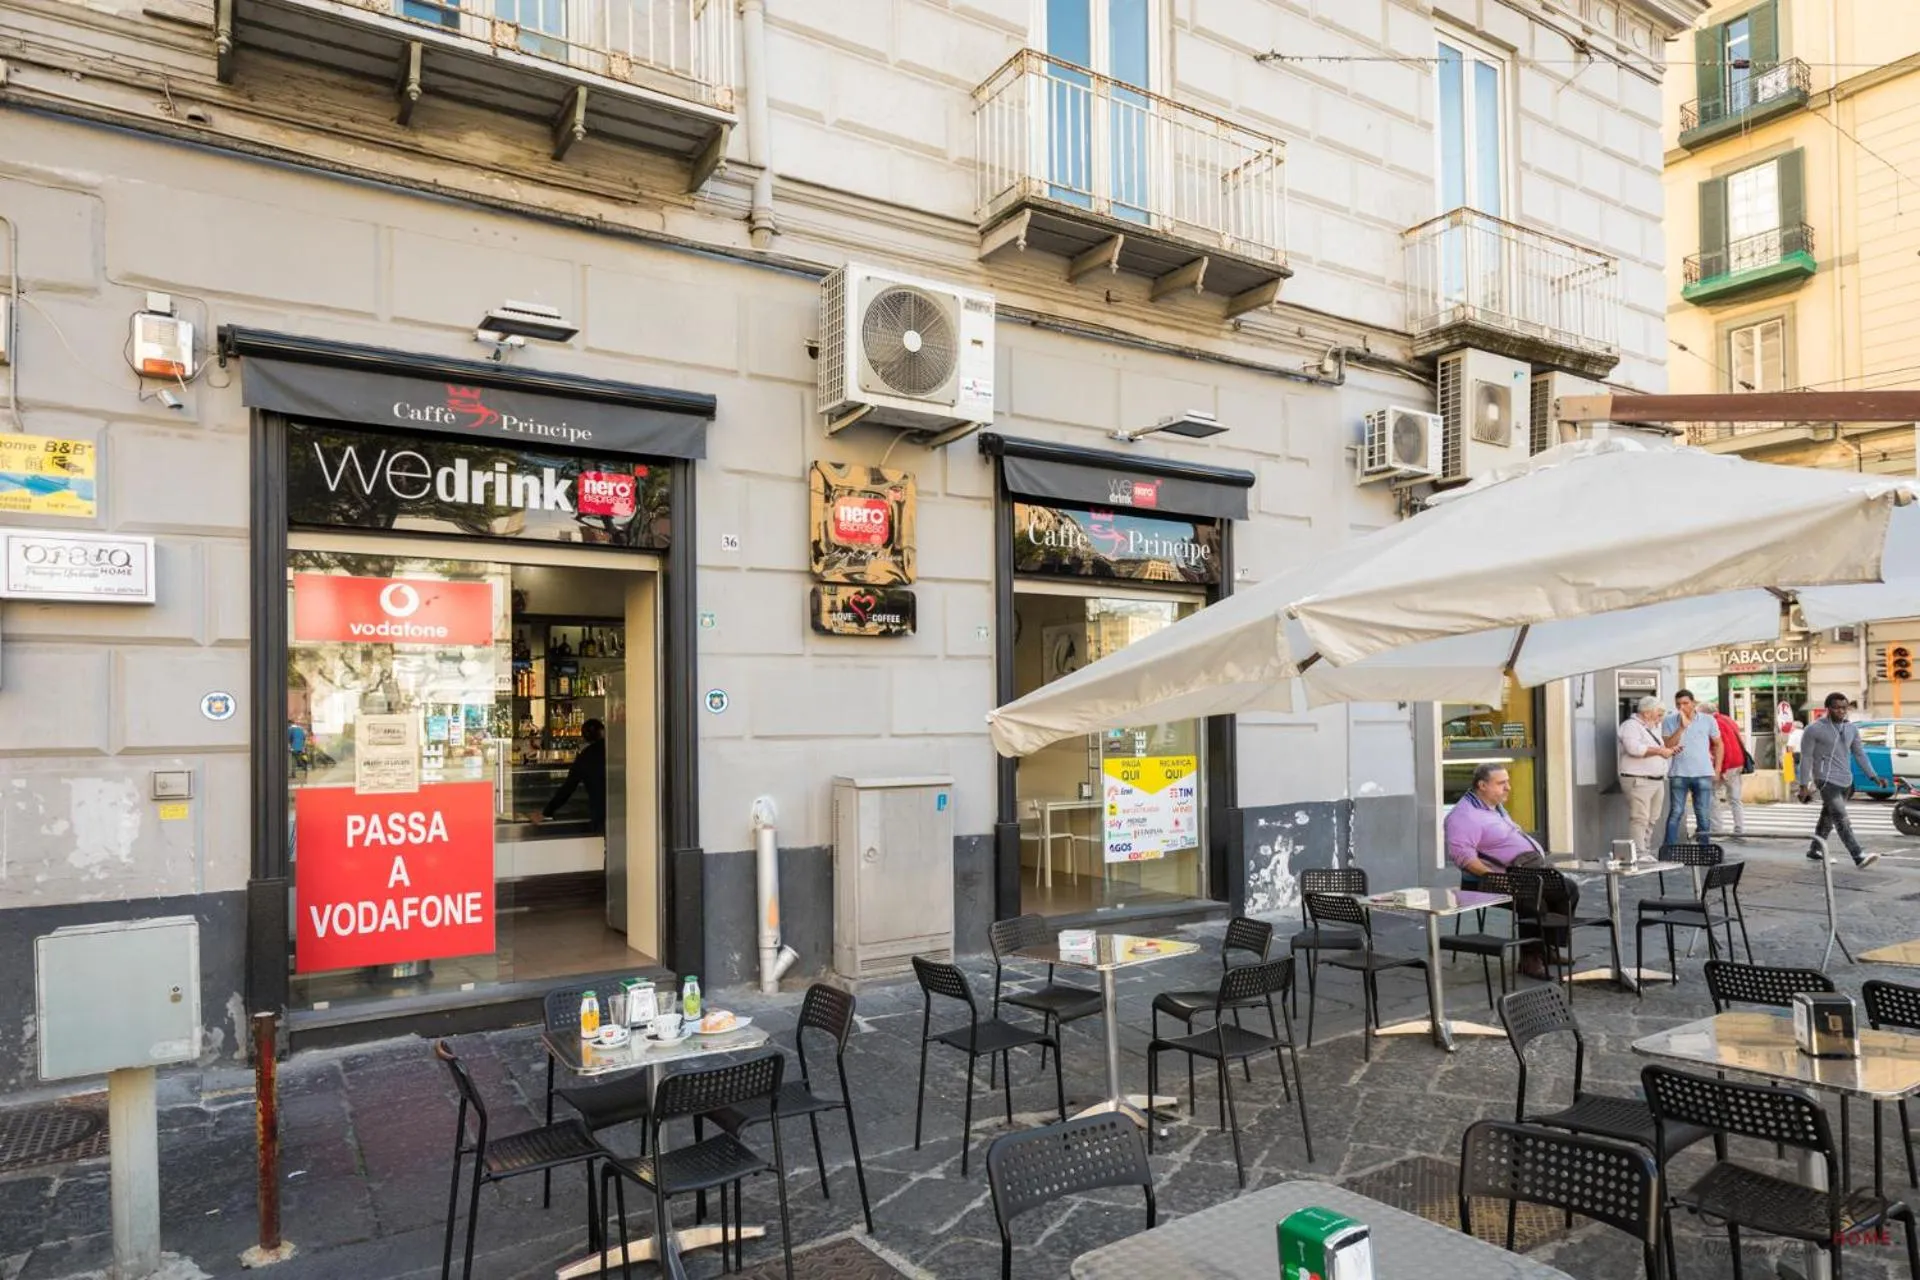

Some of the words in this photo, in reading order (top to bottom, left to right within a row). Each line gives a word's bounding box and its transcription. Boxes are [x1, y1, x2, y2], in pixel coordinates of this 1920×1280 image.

[393, 401, 456, 425] Caffè
[502, 414, 593, 442] Principe
[0, 440, 37, 452] ome
[45, 440, 85, 456] B&B
[583, 479, 631, 498] nero
[1134, 486, 1153, 498] nero
[1109, 492, 1133, 504] drink
[839, 505, 885, 524] nero
[839, 521, 885, 534] espresso
[723, 535, 737, 548] 36
[1129, 529, 1211, 565] Principe
[100, 567, 133, 576] HOME
[872, 613, 901, 624] COFFEE
[350, 620, 448, 638] vodafone
[1720, 646, 1808, 666] TABACCHI
[1121, 770, 1140, 781] QUI
[1165, 768, 1183, 780] QUI
[1179, 787, 1194, 798] TIM
[346, 810, 449, 848] PASSA
[387, 855, 411, 889] A
[309, 891, 483, 939] VODAFONE
